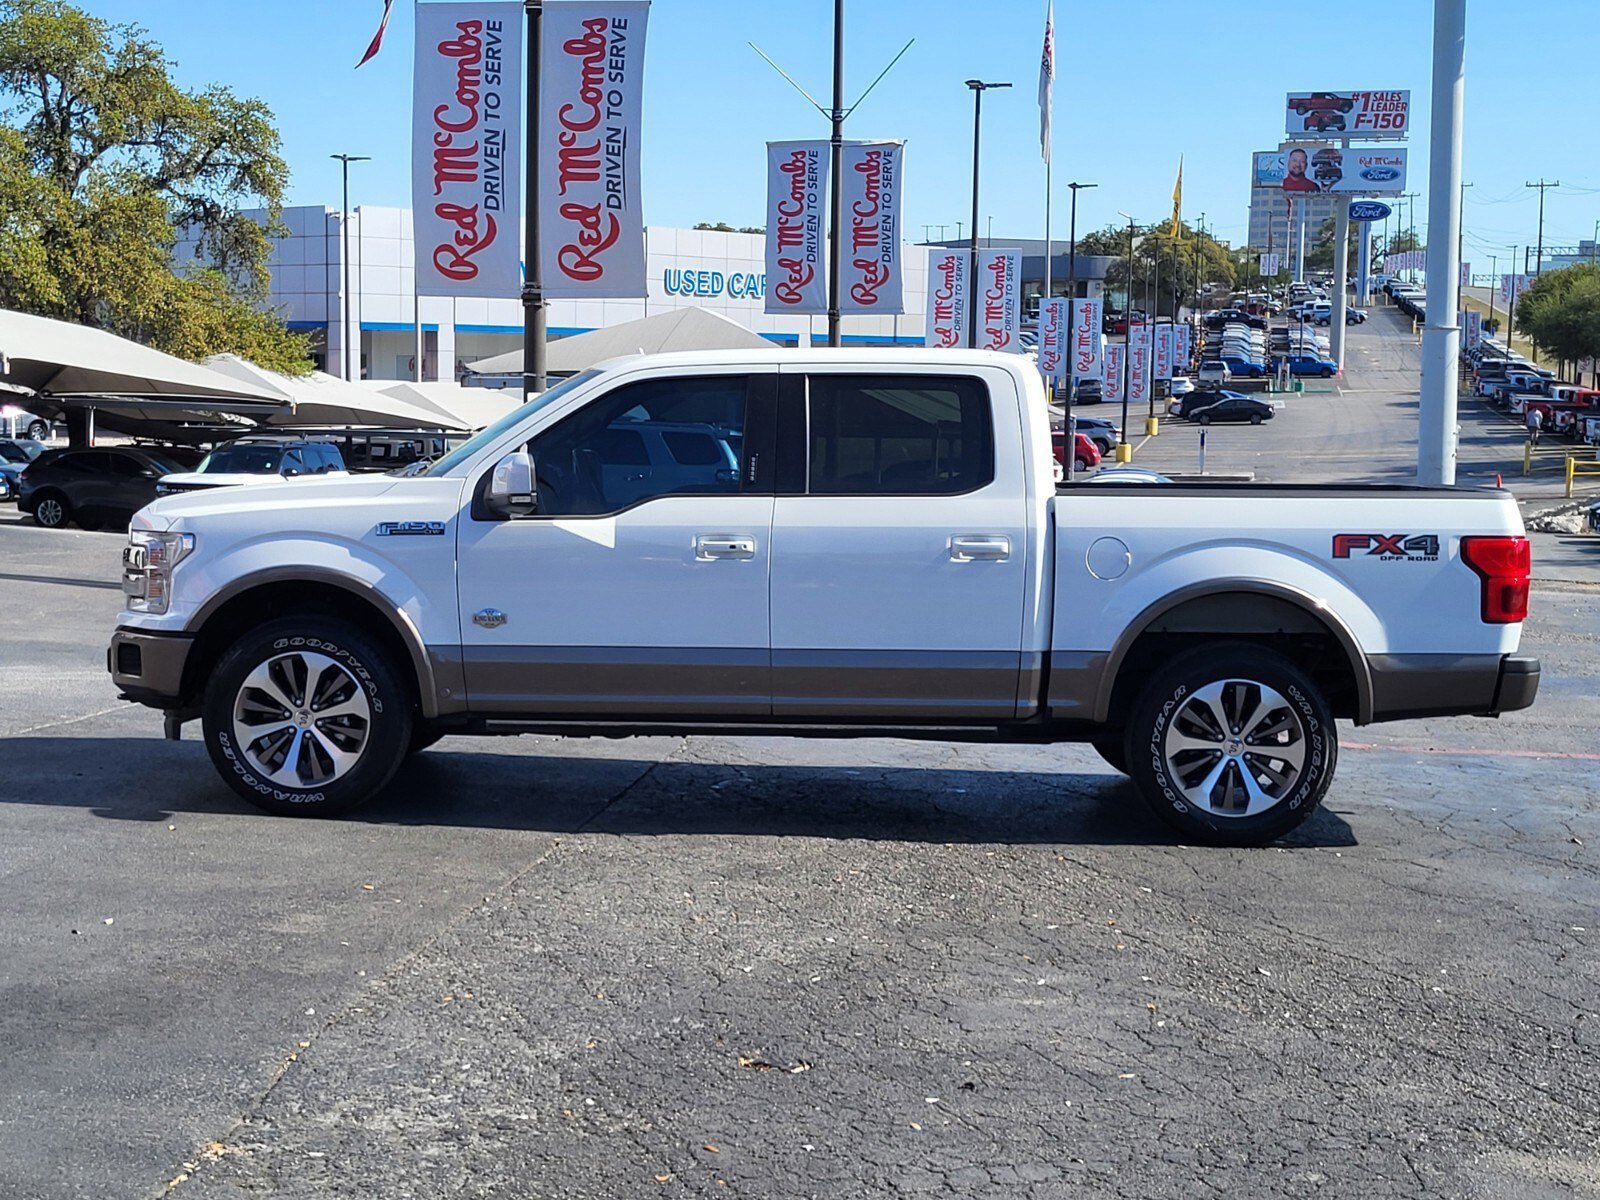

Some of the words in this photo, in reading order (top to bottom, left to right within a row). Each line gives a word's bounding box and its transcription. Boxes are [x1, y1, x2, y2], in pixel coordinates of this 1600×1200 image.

[486, 20, 502, 86] SERVE
[609, 18, 628, 84] SERVE
[433, 20, 482, 195] McCombs
[485, 93, 500, 121] TO
[559, 18, 608, 195] McCombs
[607, 91, 622, 120] TO
[1352, 92, 1371, 112] #1
[1373, 92, 1402, 101] SALES
[1354, 113, 1405, 129] F-150
[1371, 102, 1408, 112] LEADER
[484, 129, 501, 211] DRIVEN
[606, 127, 622, 210] DRIVEN
[808, 151, 818, 189] SERVE
[882, 151, 893, 188] SERVE
[1368, 170, 1392, 179] Ford
[777, 151, 806, 254] McCombs
[807, 193, 818, 210] TO
[853, 151, 881, 254] McCombs
[882, 193, 892, 210] TO
[1352, 204, 1382, 218] Ford
[433, 203, 497, 281] Red
[558, 203, 620, 281] Red
[806, 215, 817, 262] DRIVEN
[881, 215, 892, 263] DRIVEN
[665, 269, 724, 296] USED
[775, 258, 813, 305] Red
[851, 258, 889, 305] Red
[1006, 255, 1014, 282] SERVE
[955, 286, 962, 296] TO
[1005, 285, 1013, 296] TO
[954, 299, 962, 331] DRIVEN
[1042, 351, 1060, 371] Red
[1077, 351, 1095, 372] Red
[1332, 534, 1440, 558] FX4
[274, 637, 382, 713] GOODYEAR
[1150, 684, 1188, 814] GOODYEAR
[1287, 684, 1322, 810] WRANGLER
[219, 732, 324, 802] WRANGLER
